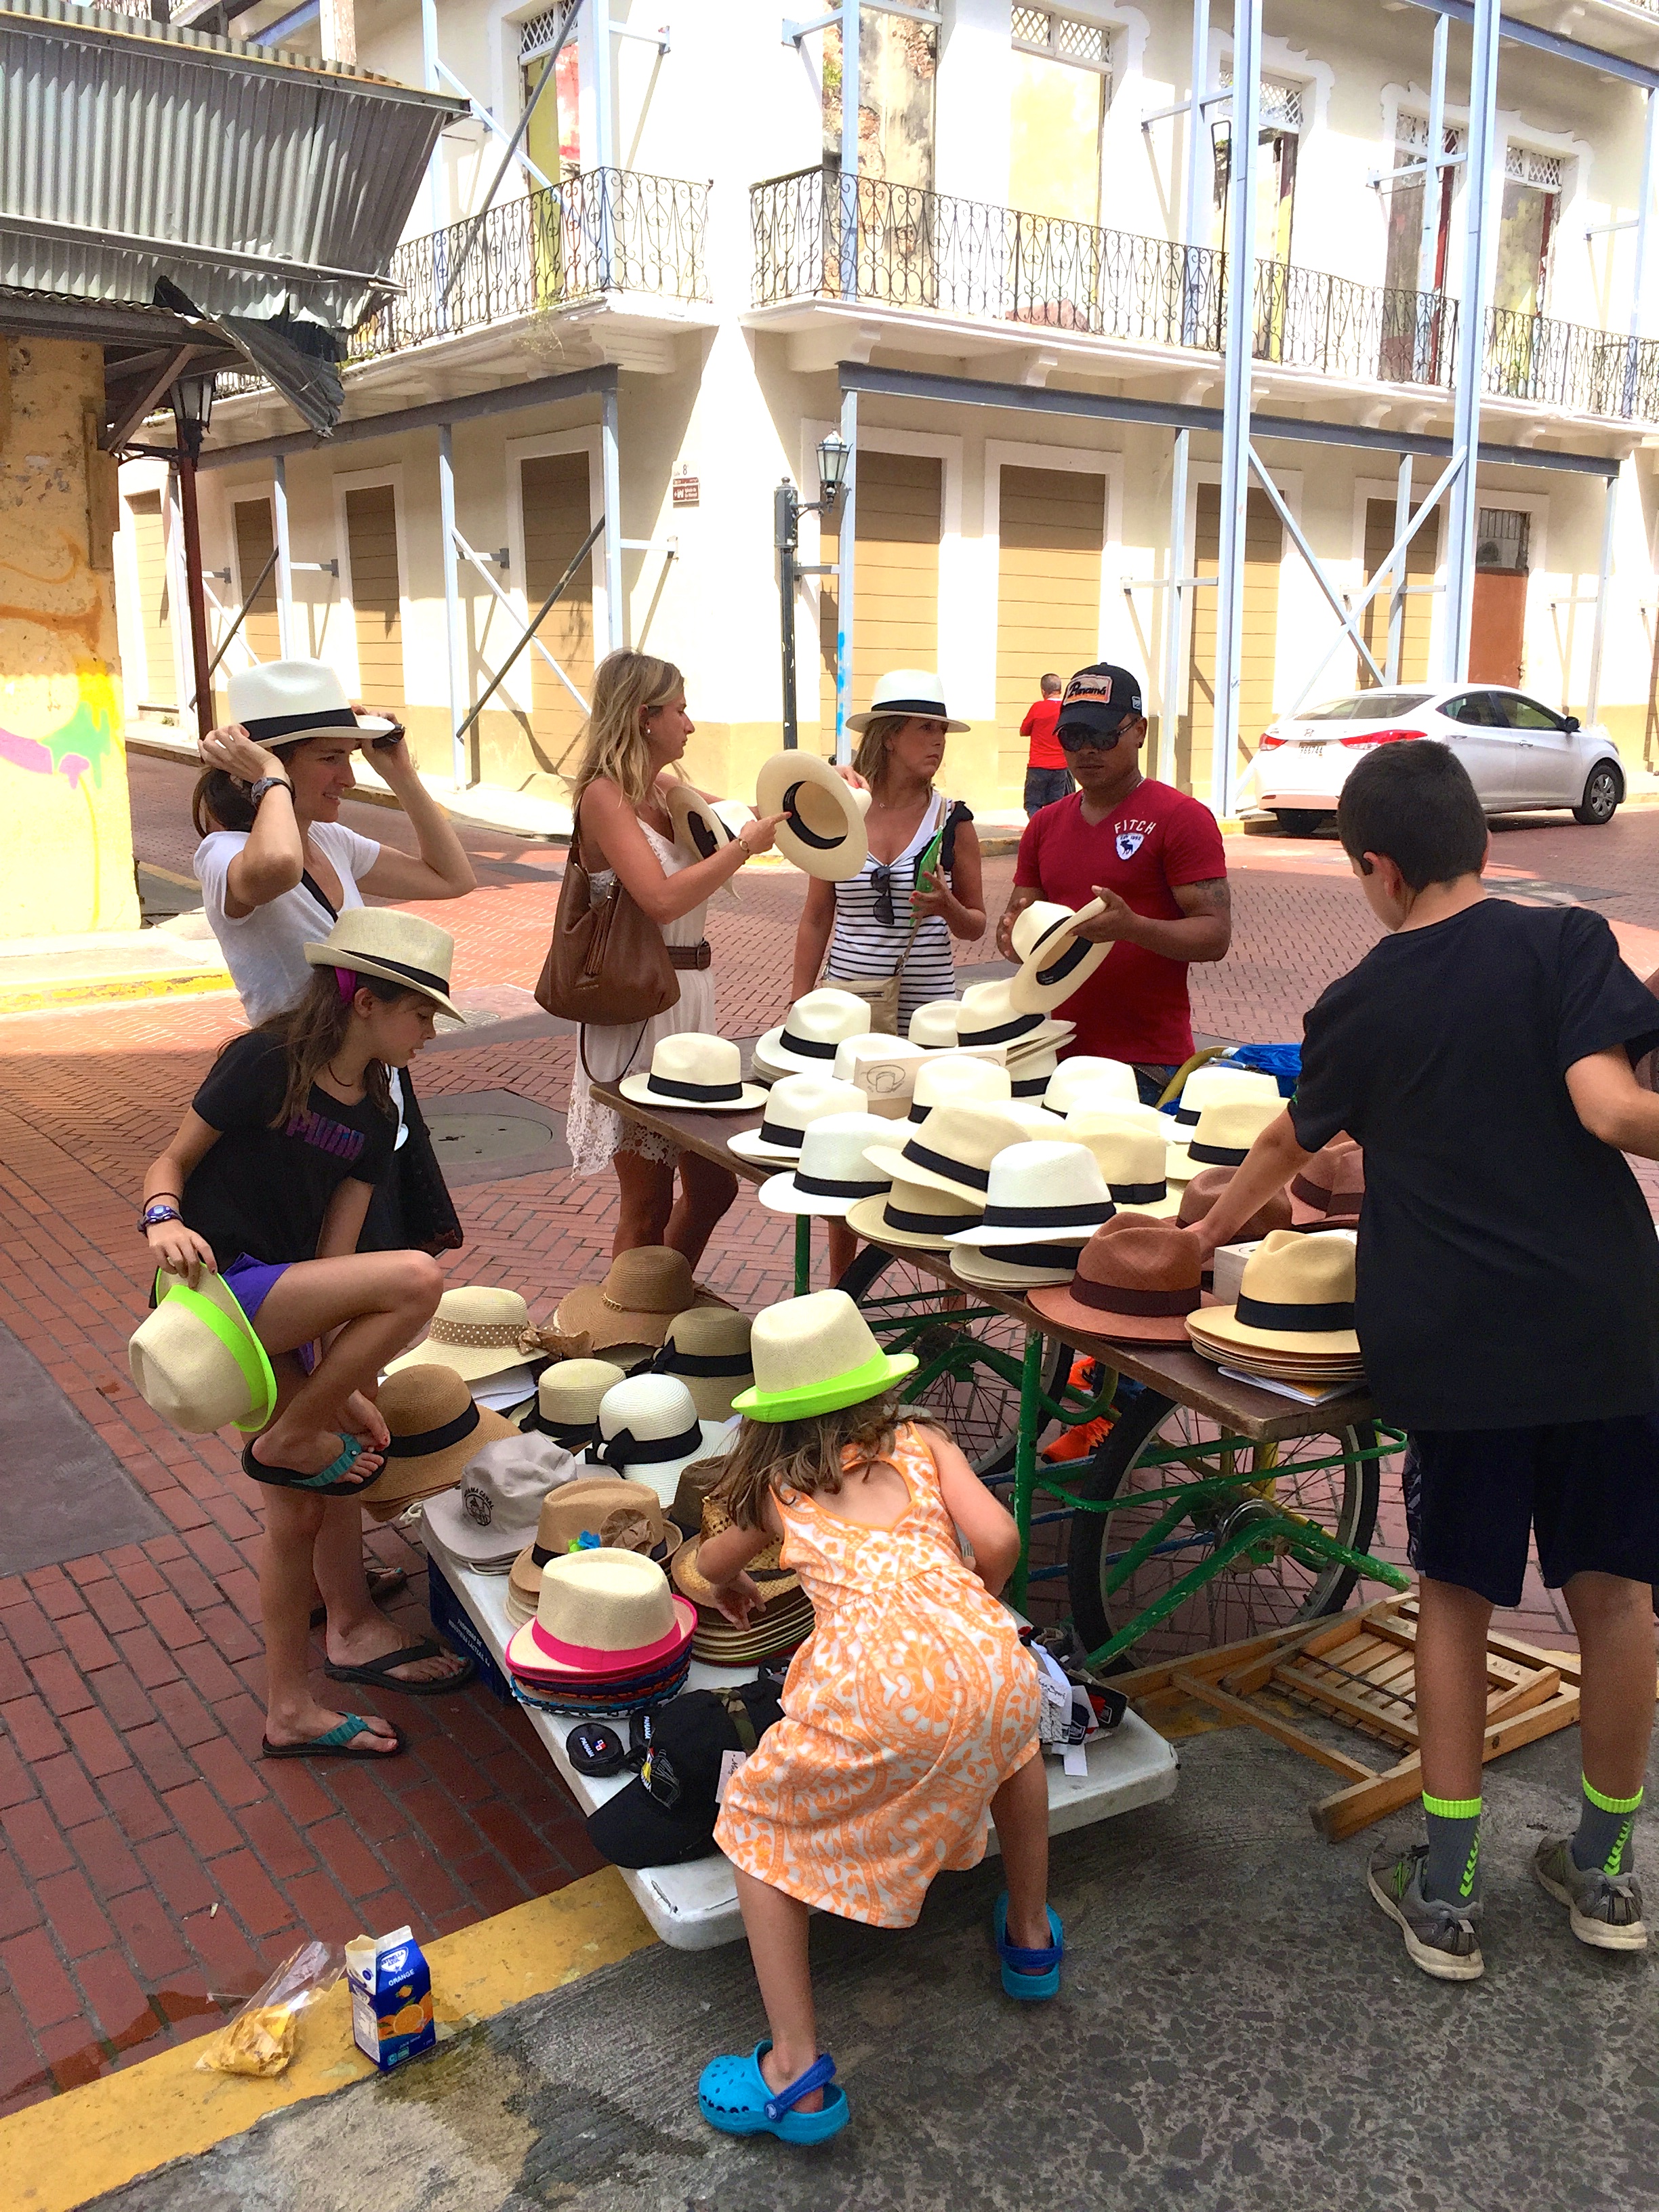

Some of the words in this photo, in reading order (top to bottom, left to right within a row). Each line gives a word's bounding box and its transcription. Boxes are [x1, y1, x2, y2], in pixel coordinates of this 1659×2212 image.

[1114, 819, 1157, 835] FITCH
[579, 1737, 595, 1758] PANAMA
[388, 1969, 415, 1986] ORANGE
